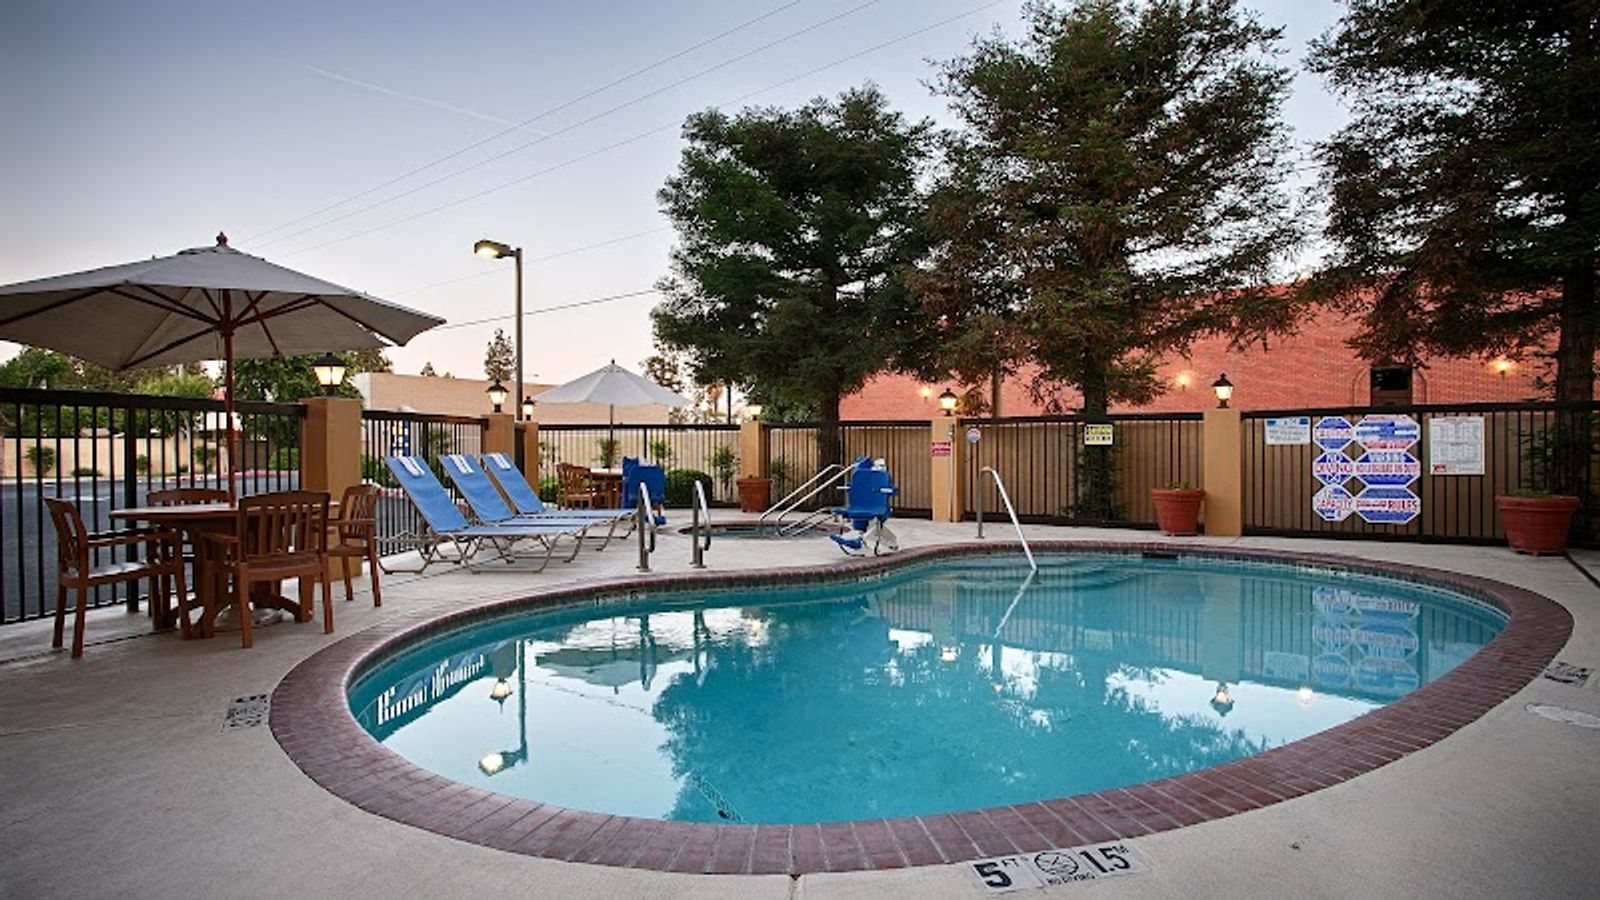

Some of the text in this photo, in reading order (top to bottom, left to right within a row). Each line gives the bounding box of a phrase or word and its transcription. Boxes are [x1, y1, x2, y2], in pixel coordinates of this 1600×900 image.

[1315, 464, 1353, 473] DIVING
[1388, 500, 1418, 510] RULES
[1080, 847, 1131, 874] 1.5
[973, 861, 1012, 888] 5
